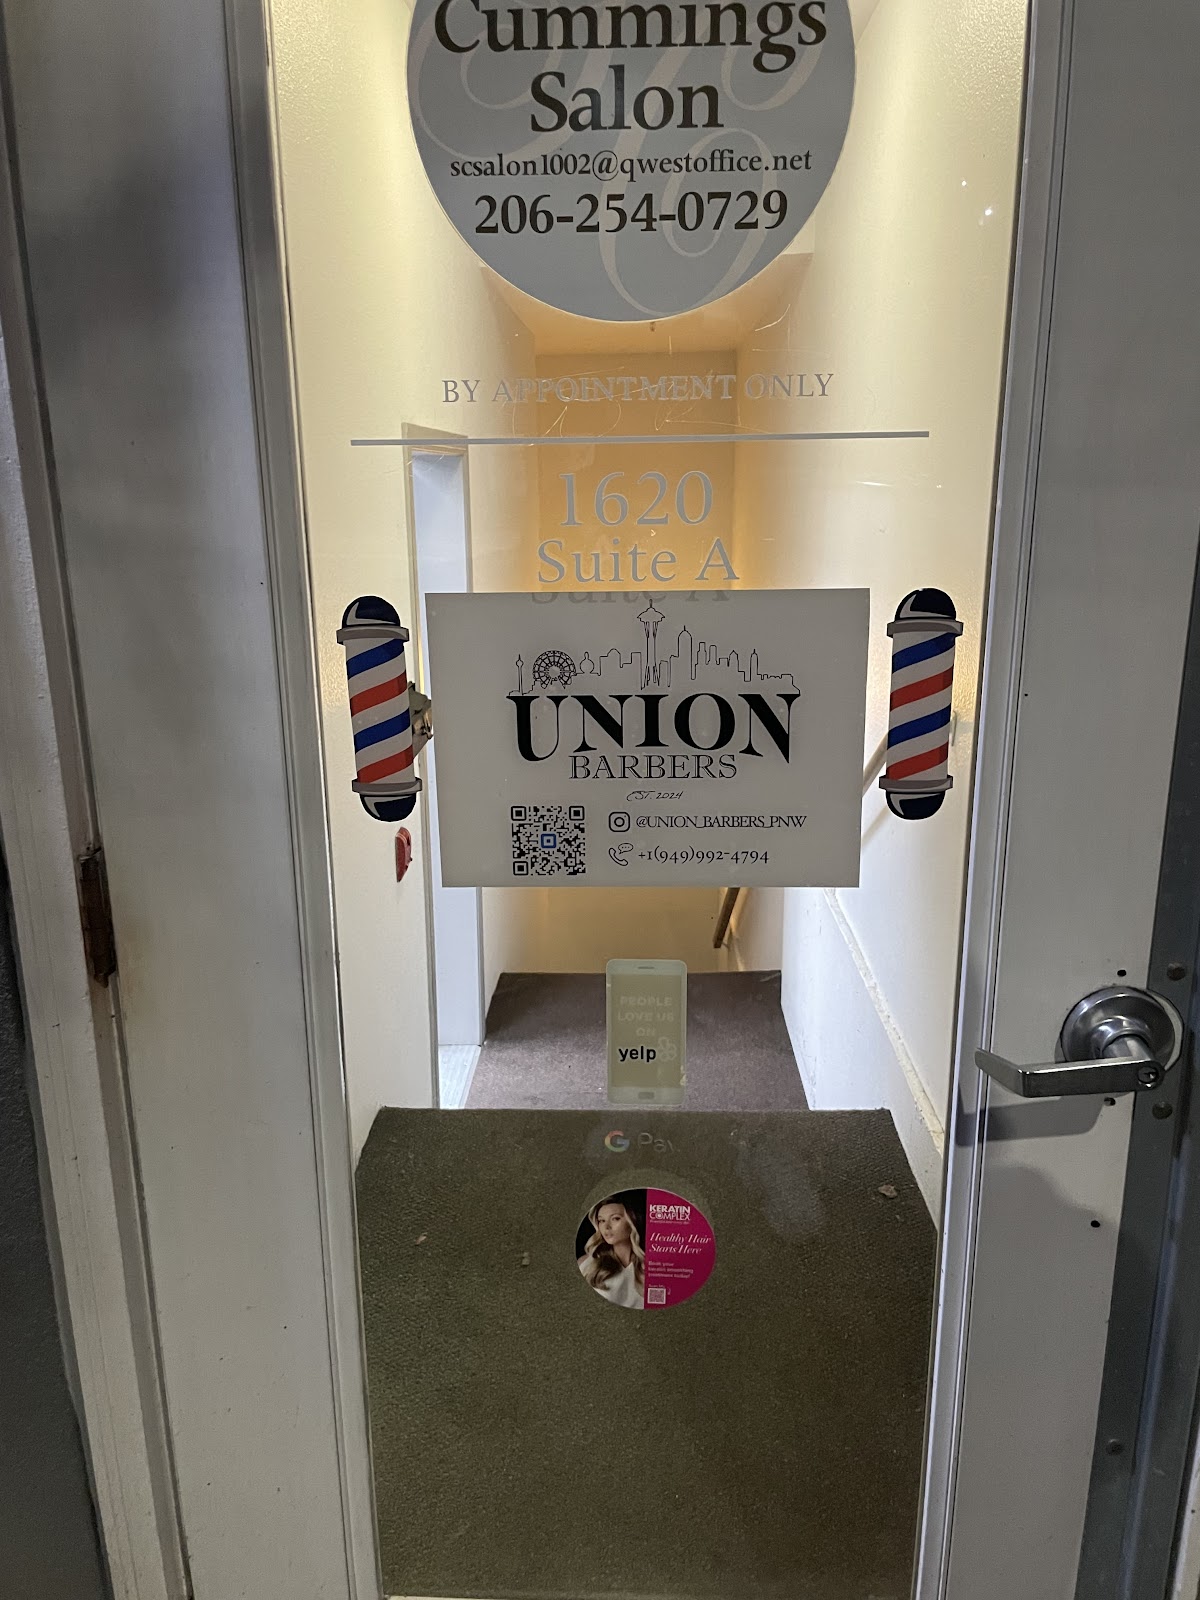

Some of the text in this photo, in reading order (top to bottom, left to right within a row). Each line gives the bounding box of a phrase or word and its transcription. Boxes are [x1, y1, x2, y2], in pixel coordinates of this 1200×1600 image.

[434, 0, 827, 73] Cummings
[530, 64, 725, 132] Salon
[450, 149, 812, 182] scsalon1002@qwestoffice.net
[474, 190, 788, 234] 206-254-0729
[442, 373, 834, 404] BY APPOINTMENT ONLY
[559, 470, 713, 526] 1620
[538, 537, 740, 583] Suite A
[506, 693, 800, 764] UNION
[568, 754, 737, 779] BARBERS
[656, 791, 684, 800] 2024
[636, 815, 807, 829] @UNION_BARBERS_PNW
[638, 845, 770, 864] +1(949)992-4794
[620, 996, 673, 1006] PEOPLE
[617, 1012, 674, 1022] LOVE US
[636, 1028, 656, 1037] ON
[618, 1045, 657, 1063] yelp
[604, 1130, 630, 1153] G
[649, 1204, 691, 1213] KERATIN
[649, 1211, 691, 1221] COMPLEX
[650, 1232, 712, 1244] Healthy Hair
[649, 1244, 702, 1254] Starts Here
